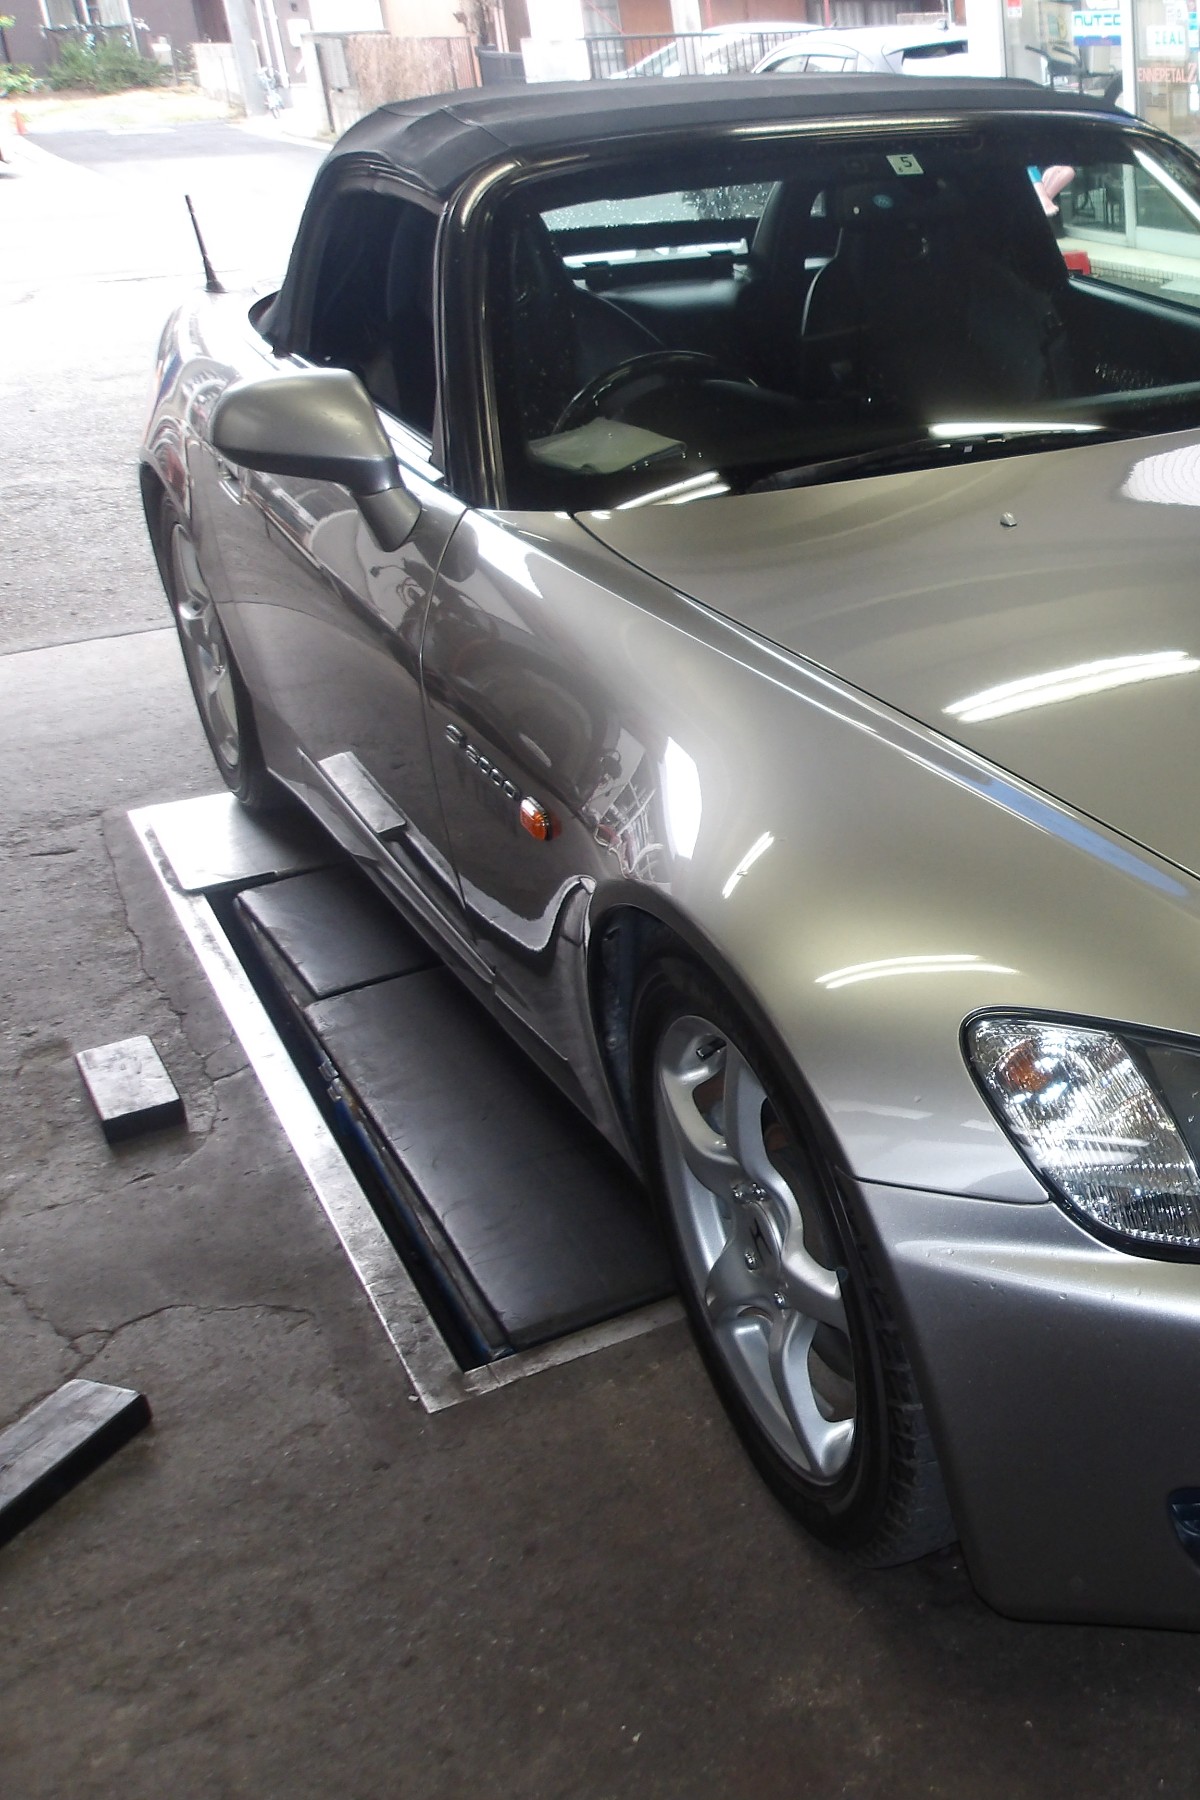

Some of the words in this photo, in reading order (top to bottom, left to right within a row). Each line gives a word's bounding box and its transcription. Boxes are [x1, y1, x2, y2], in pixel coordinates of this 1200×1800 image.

[1154, 30, 1184, 45] ZEAL
[900, 156, 912, 167] 5
[445, 723, 522, 801] S2000
